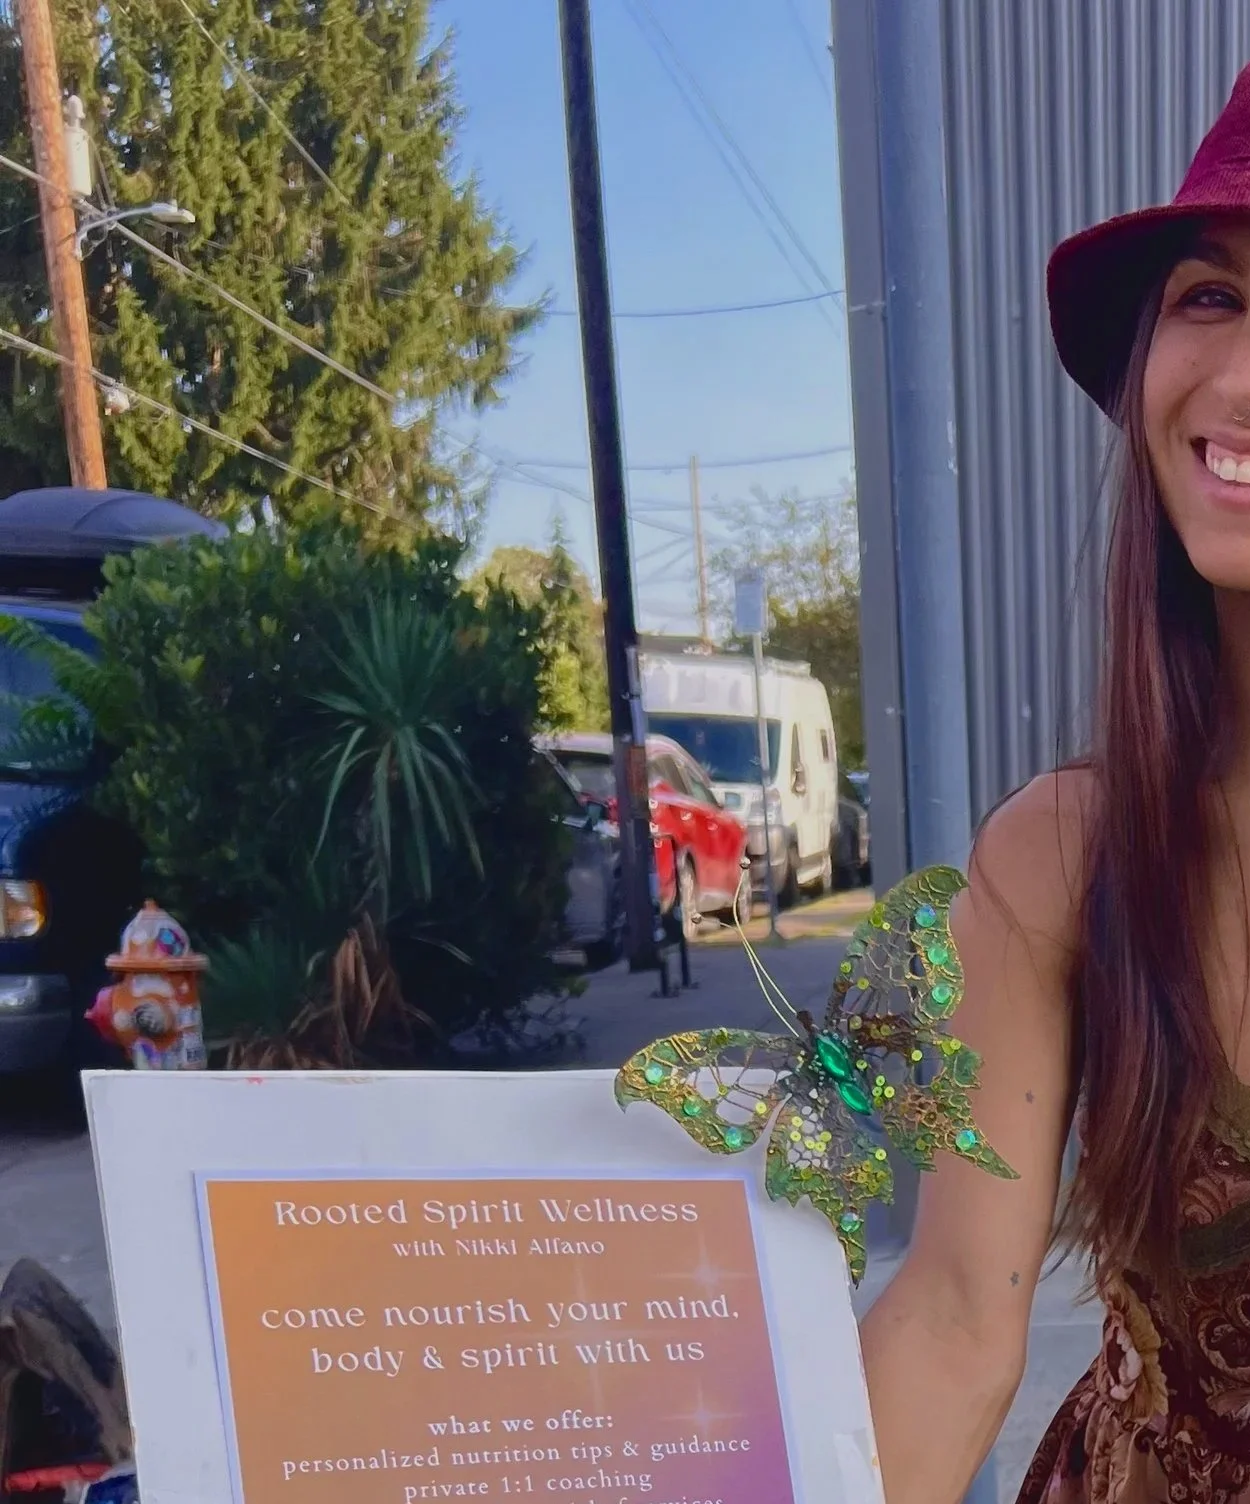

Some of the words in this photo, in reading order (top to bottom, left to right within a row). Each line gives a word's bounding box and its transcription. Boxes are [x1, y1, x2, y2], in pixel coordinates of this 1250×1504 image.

[273, 1198, 409, 1226] Rooted
[422, 1199, 525, 1231] Spirit
[538, 1197, 699, 1223] Wellness
[391, 1238, 446, 1258] with
[455, 1237, 518, 1257] Nikki
[528, 1236, 605, 1256] Alfano
[260, 1306, 367, 1330] come
[383, 1297, 533, 1327] nourish
[546, 1300, 628, 1329] your
[644, 1293, 740, 1320] mind,
[310, 1345, 404, 1378] body
[422, 1344, 446, 1370] &
[460, 1341, 560, 1375] spirit
[574, 1337, 652, 1365] with
[664, 1341, 705, 1362] us
[427, 1414, 492, 1436] what
[500, 1418, 535, 1433] we
[544, 1408, 614, 1431] offer:
[281, 1445, 441, 1481] personalized
[450, 1444, 562, 1466] nutrition
[570, 1441, 613, 1466] tips
[621, 1439, 640, 1458] &
[649, 1433, 751, 1463] guidance
[500, 1474, 535, 1494] 1:1
[546, 1467, 654, 1493] coaching
